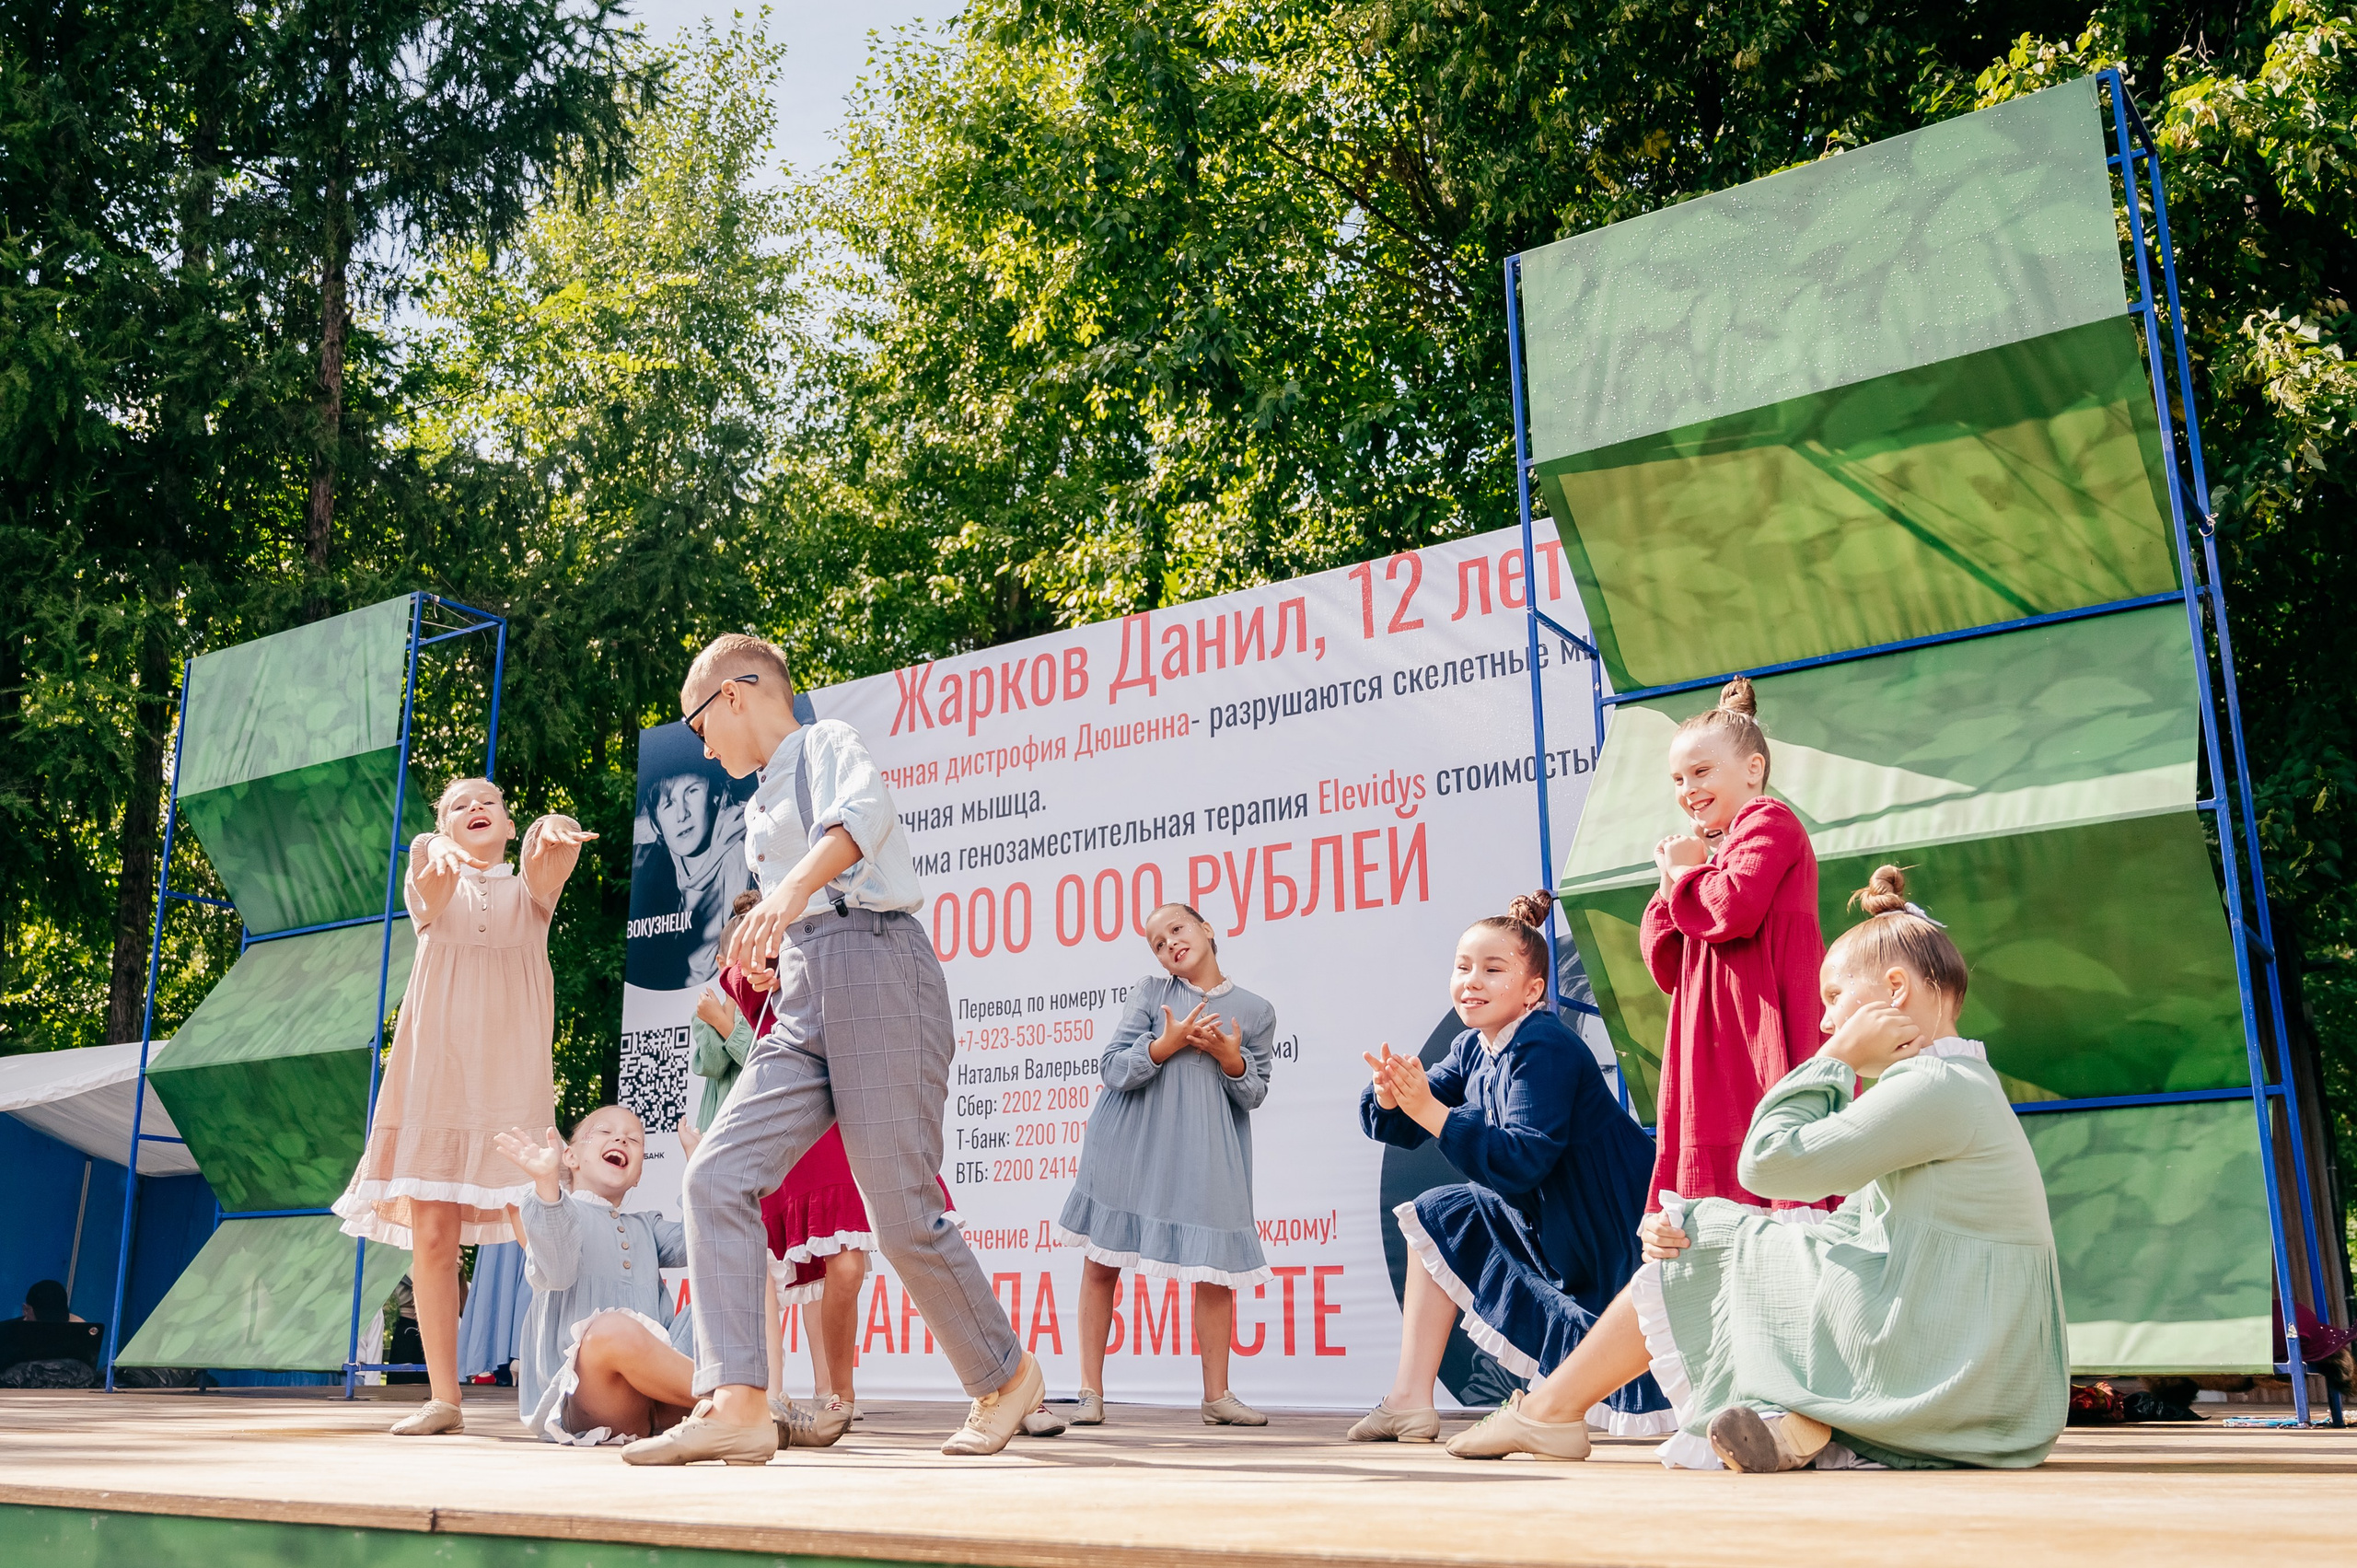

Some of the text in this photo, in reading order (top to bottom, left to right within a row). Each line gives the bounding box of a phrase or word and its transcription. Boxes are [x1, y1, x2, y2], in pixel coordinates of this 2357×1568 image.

[889, 540, 1563, 737] Жарков Данил, 12 лет
[945, 735, 1066, 785] дистрофия
[1210, 675, 1383, 738] разрушаются
[1393, 643, 1549, 695] скелетные
[959, 810, 1196, 871] генозаместительная
[1204, 793, 1308, 835] терапия
[1318, 769, 1426, 815] Elevidys
[961, 790, 1047, 825] мышца.
[933, 803, 1430, 962] 000 000 РУБЛЕЙ
[626, 911, 692, 939] ВОКУЗНЕЦК
[958, 985, 1135, 1022] Перевод по номеру те
[958, 1018, 1094, 1051] +7-923-530-5550
[958, 1063, 1019, 1086] Наталья
[957, 1086, 1089, 1120] Сбер: 2202 2080
[956, 1128, 1010, 1150] Т-банк:
[1015, 1122, 1056, 1147] 2200
[956, 1156, 1078, 1184] ВТБ: 2200 2414
